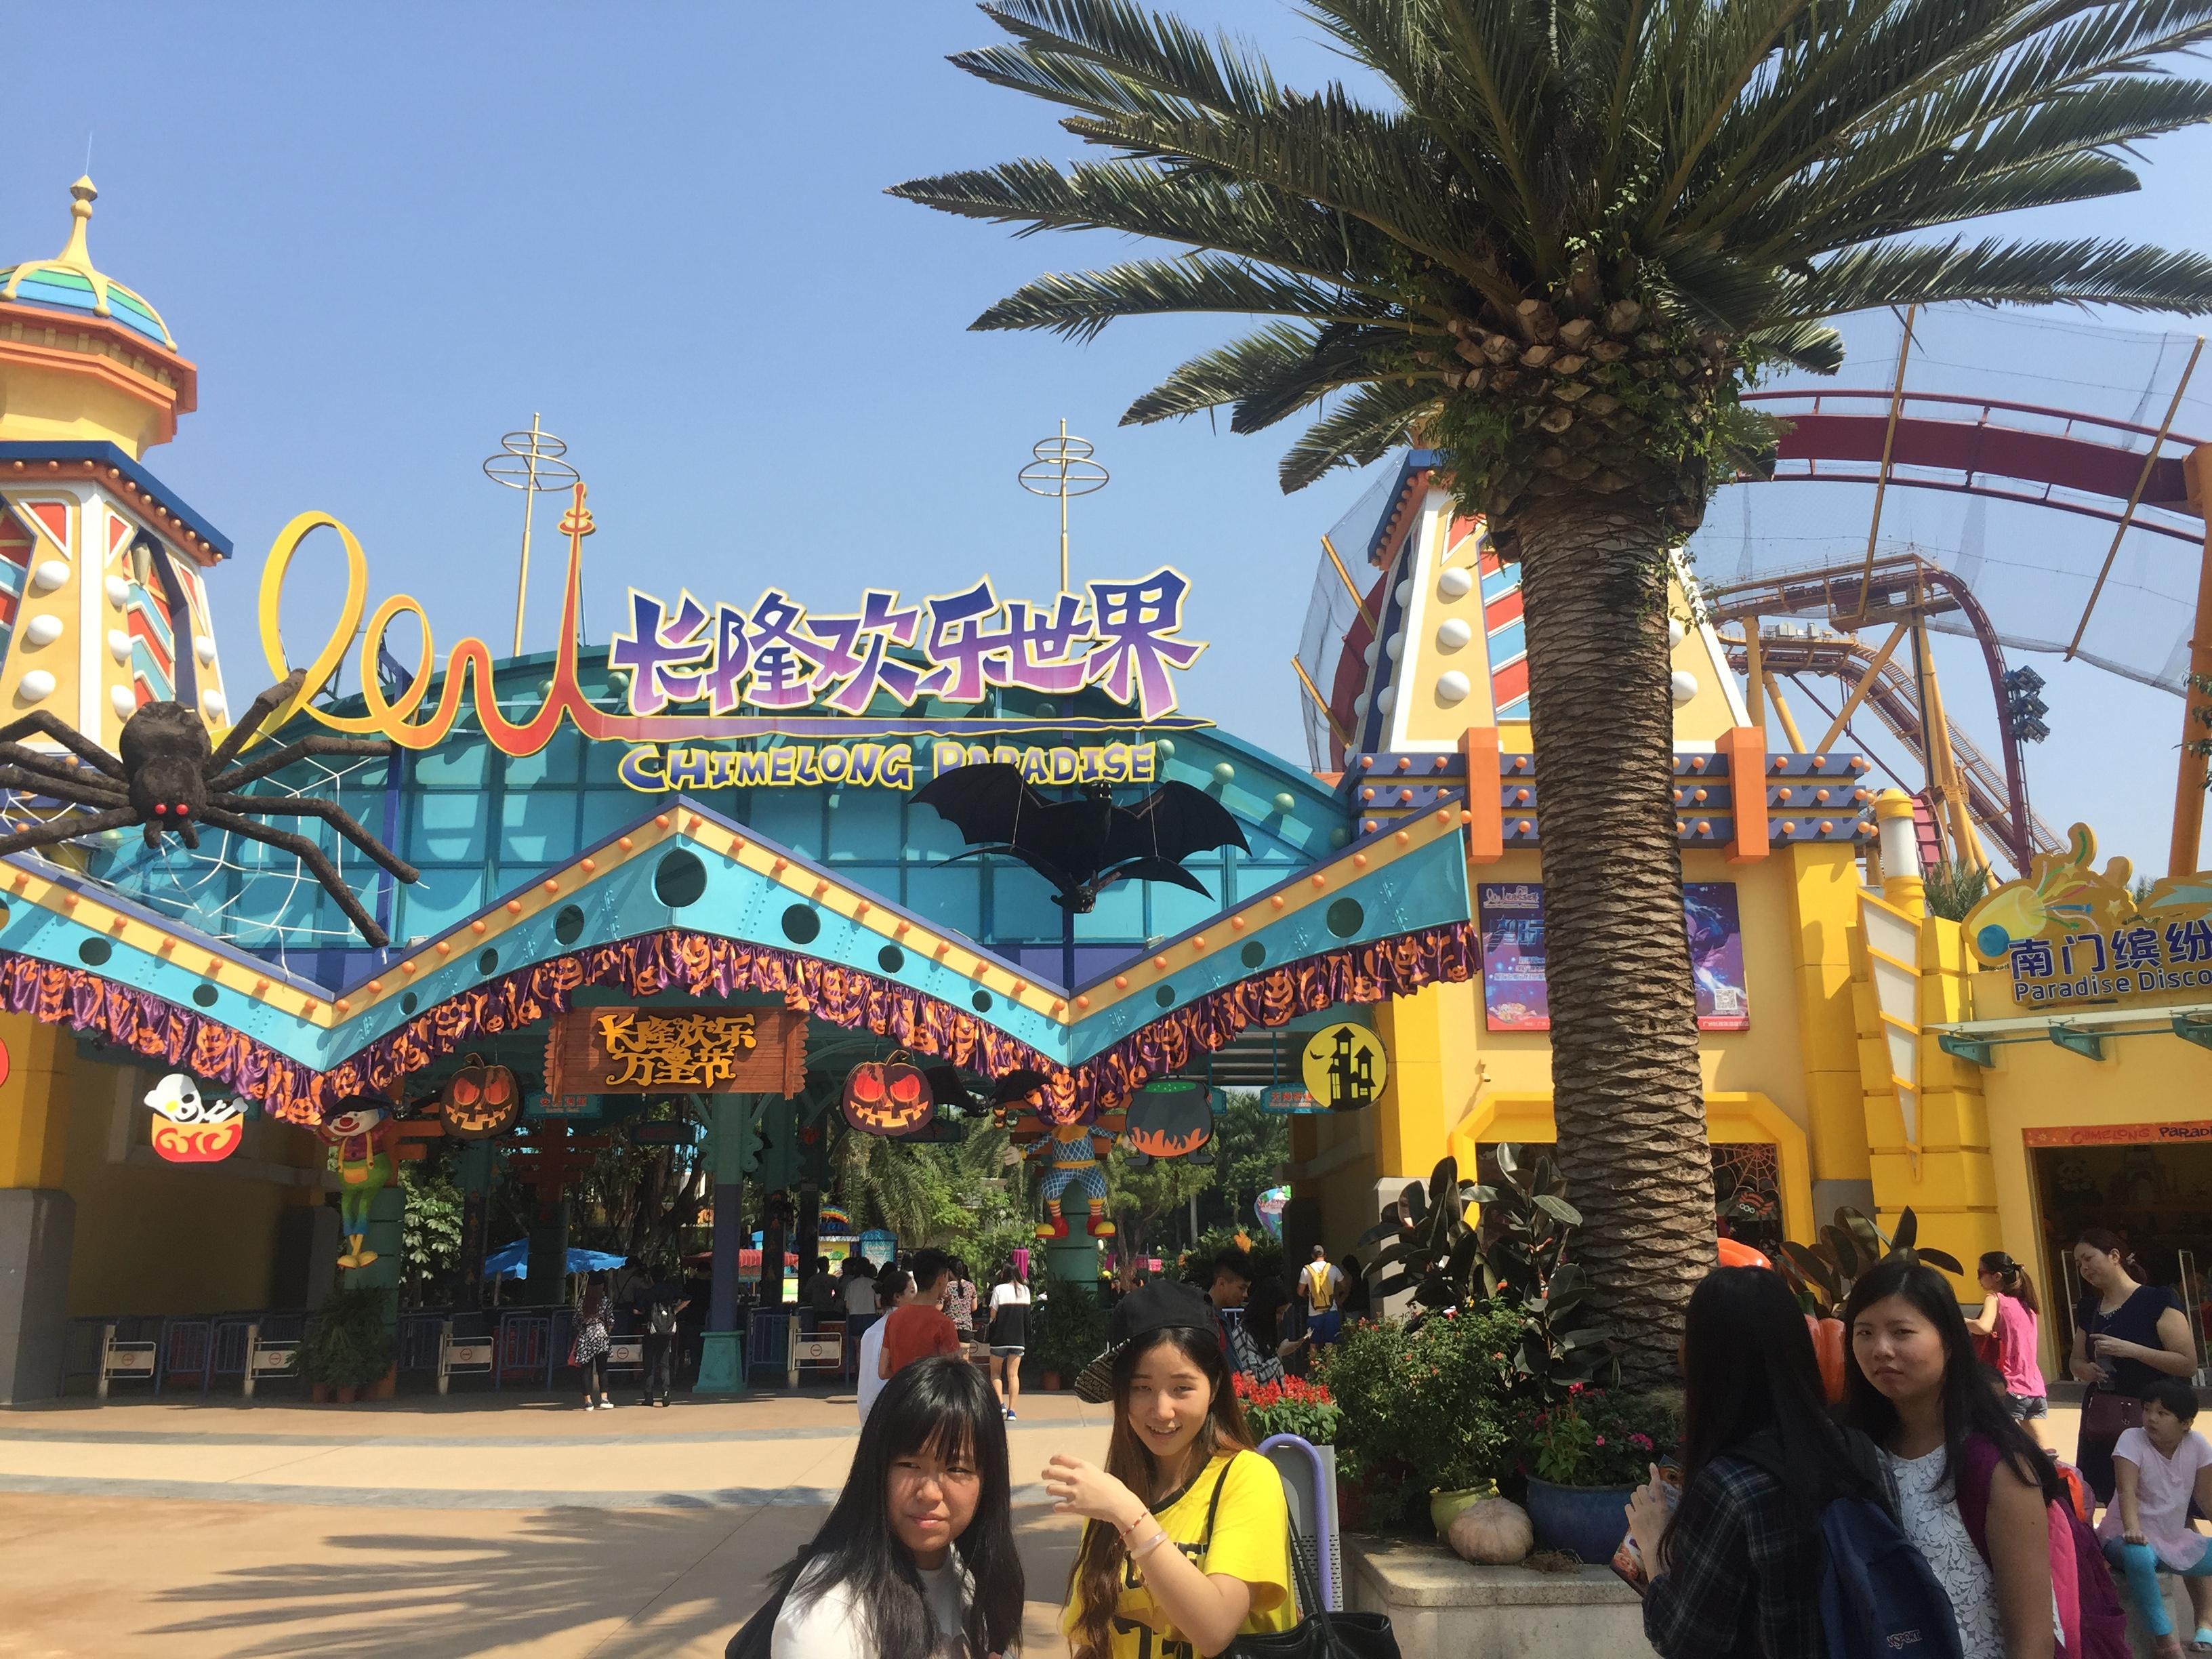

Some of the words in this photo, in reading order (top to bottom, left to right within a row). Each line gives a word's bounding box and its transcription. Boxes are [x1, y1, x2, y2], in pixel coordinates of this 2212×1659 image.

[608, 565, 1210, 723] 长隆欢乐世界
[617, 744, 914, 793] CHIMELONG
[2008, 918, 2212, 981] 南门缤纷
[2013, 975, 2131, 1002] Paradise
[597, 1012, 757, 1054] 长隆欢乐
[605, 1046, 737, 1089] 万圣节
[2070, 1128, 2150, 1145] CHIMELONG
